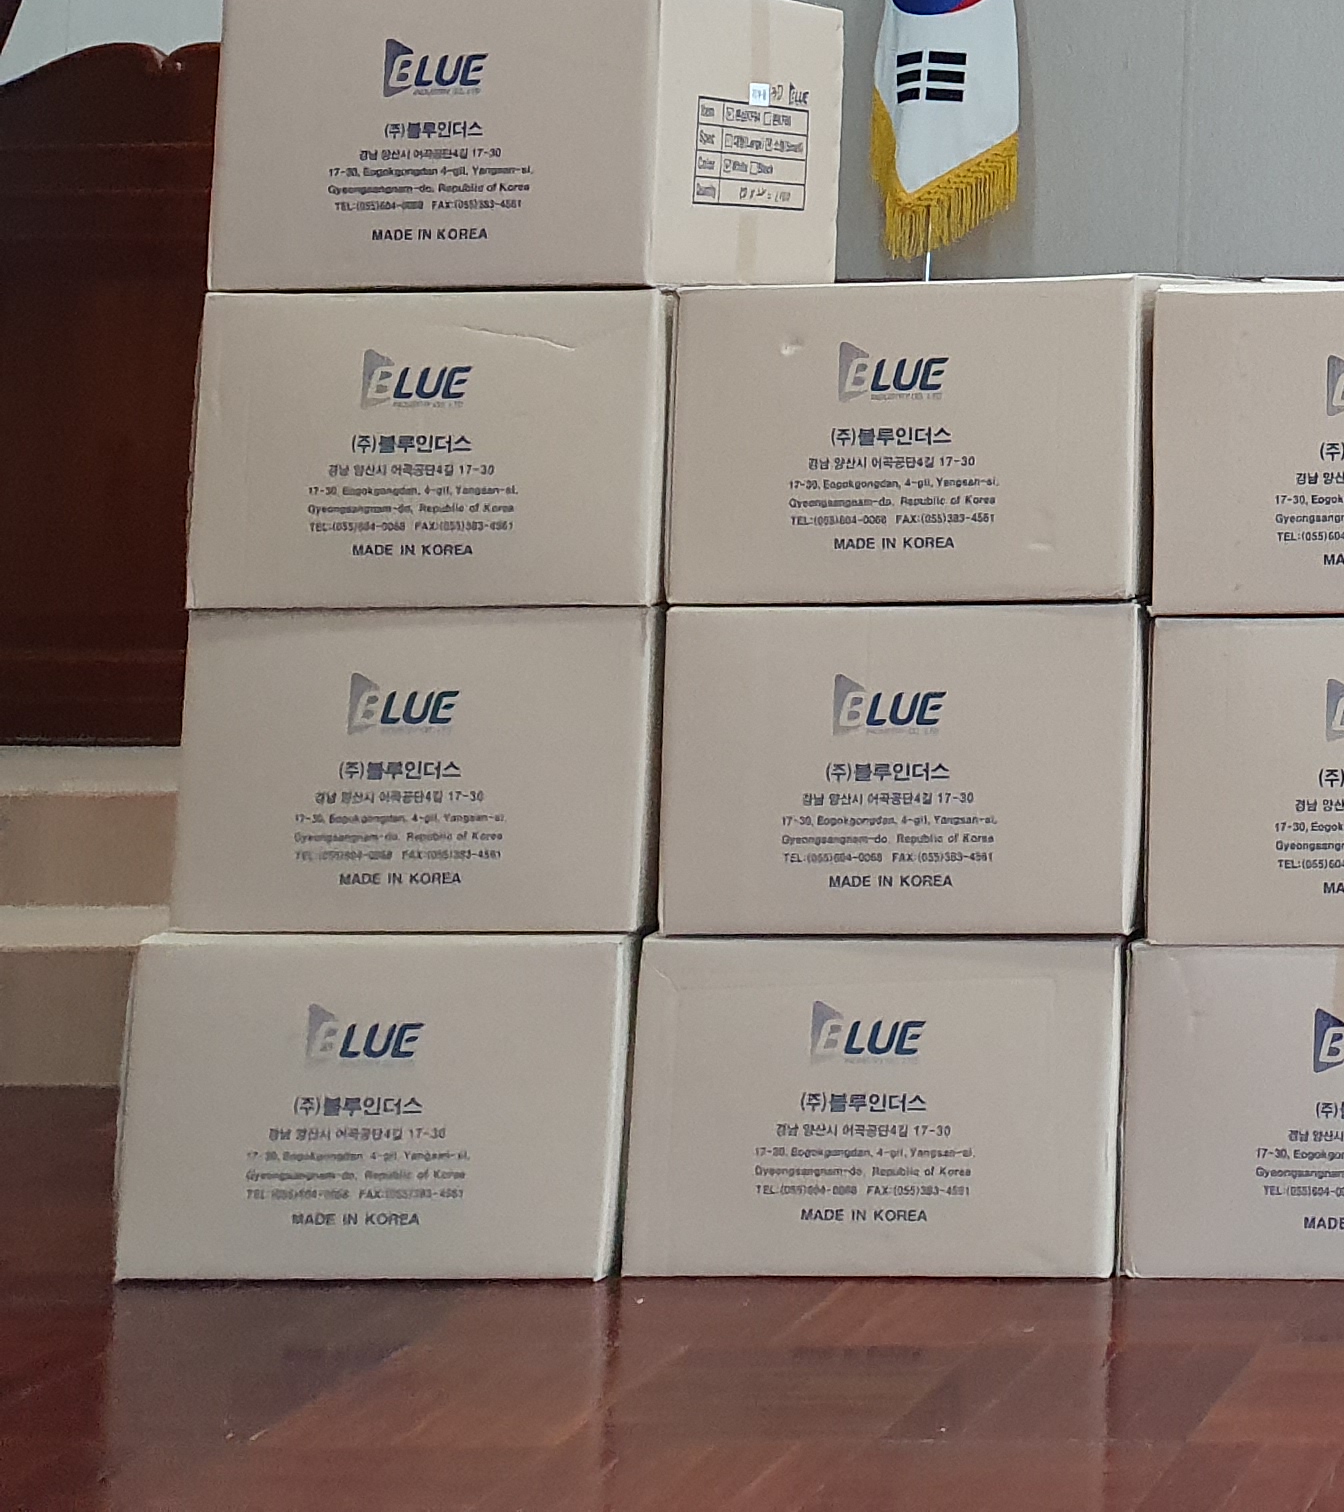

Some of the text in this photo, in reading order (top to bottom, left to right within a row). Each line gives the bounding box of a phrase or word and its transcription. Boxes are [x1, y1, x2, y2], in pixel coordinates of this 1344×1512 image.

[385, 46, 489, 92] BLUE
[371, 227, 488, 242] MADE IN KOREA
[363, 357, 474, 402] BLUE
[841, 350, 950, 395] BLUE
[351, 433, 473, 455] (주)블루인더스
[830, 425, 953, 448] (주)블루인더스
[350, 681, 461, 729] BLUE
[835, 682, 948, 730] BLUE
[338, 759, 462, 782] (주)블루인더스
[825, 761, 951, 784] (주)블루인더스
[309, 1011, 426, 1060] BLUE
[813, 1008, 928, 1057] BLUE
[799, 1091, 928, 1114] (주)블루인더스
[800, 1207, 928, 1223] MADE IN KOREA
